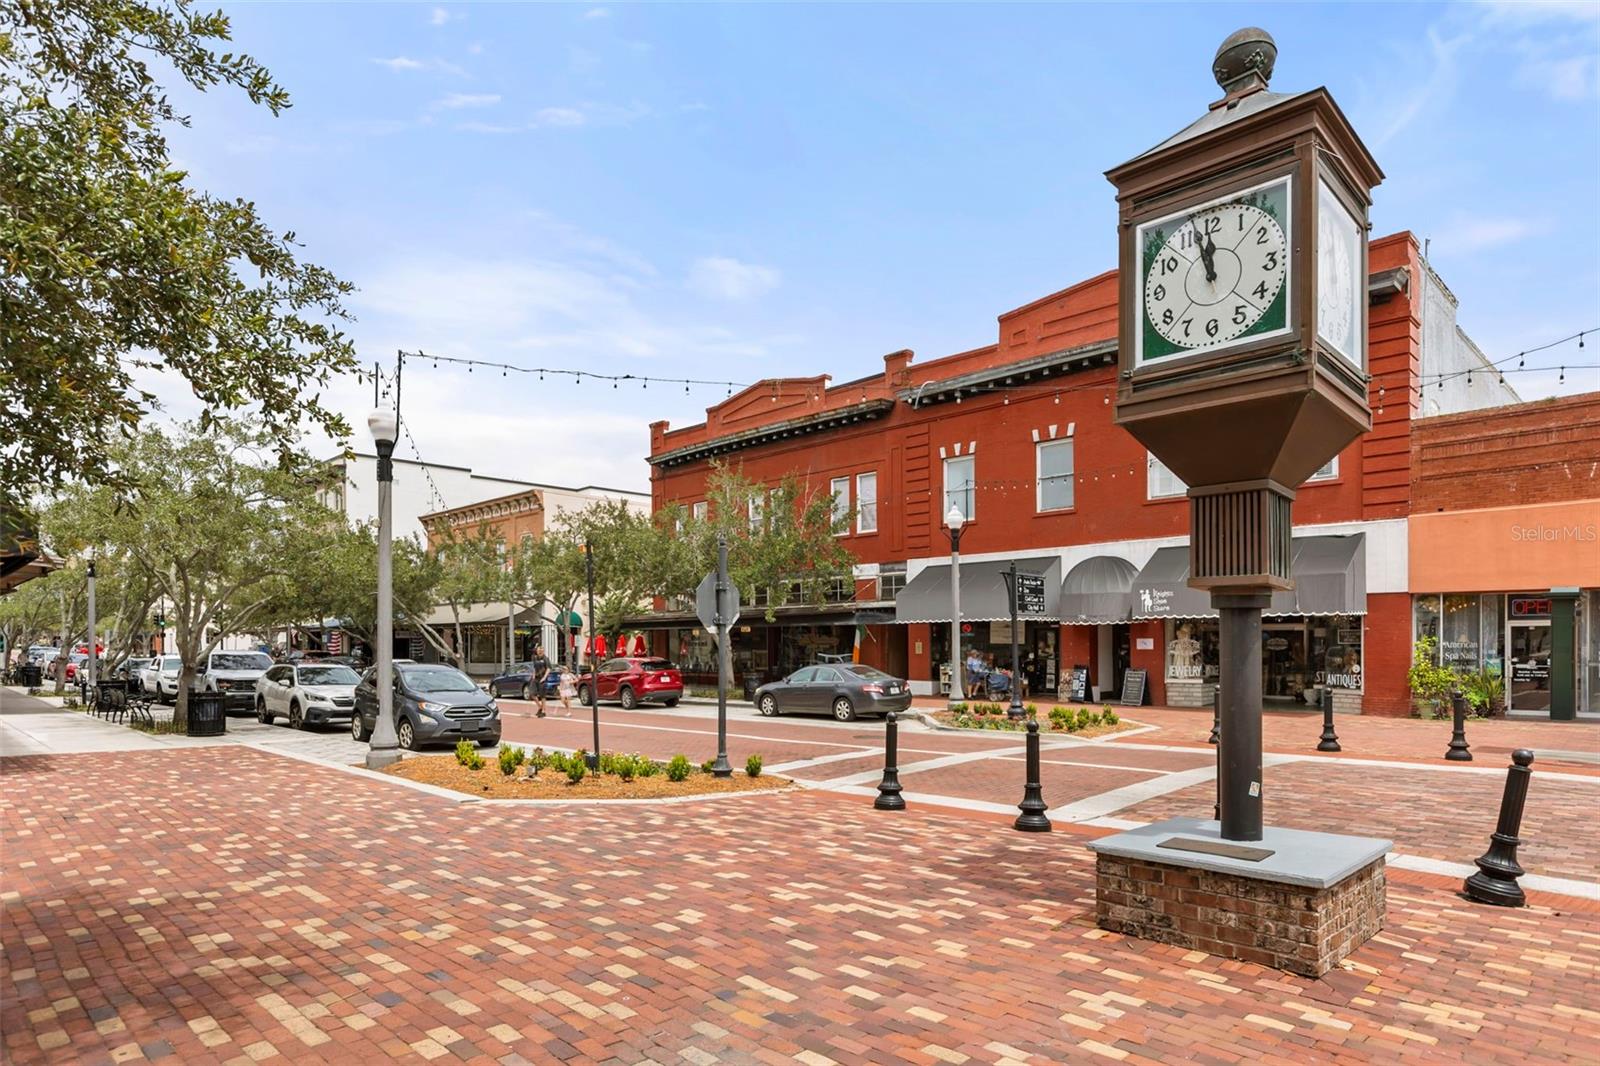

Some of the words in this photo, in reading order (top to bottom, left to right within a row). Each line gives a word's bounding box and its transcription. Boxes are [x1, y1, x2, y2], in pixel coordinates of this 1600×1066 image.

[1204, 216, 1222, 236] 12
[1238, 213, 1244, 231] 1
[1180, 230, 1193, 250] 11
[1256, 226, 1269, 245] 2
[1161, 256, 1178, 276] 10
[1262, 251, 1278, 271] 3
[1153, 284, 1166, 301] 9
[1252, 280, 1269, 300] 4
[1162, 308, 1174, 326] 8
[1232, 305, 1248, 325] 5
[1181, 317, 1194, 337] 7
[1205, 318, 1219, 338] 6
[1445, 652, 1459, 661] Spa
[1168, 665, 1202, 677] JEWELRY
[1326, 673, 1361, 687] ANTIQUES
